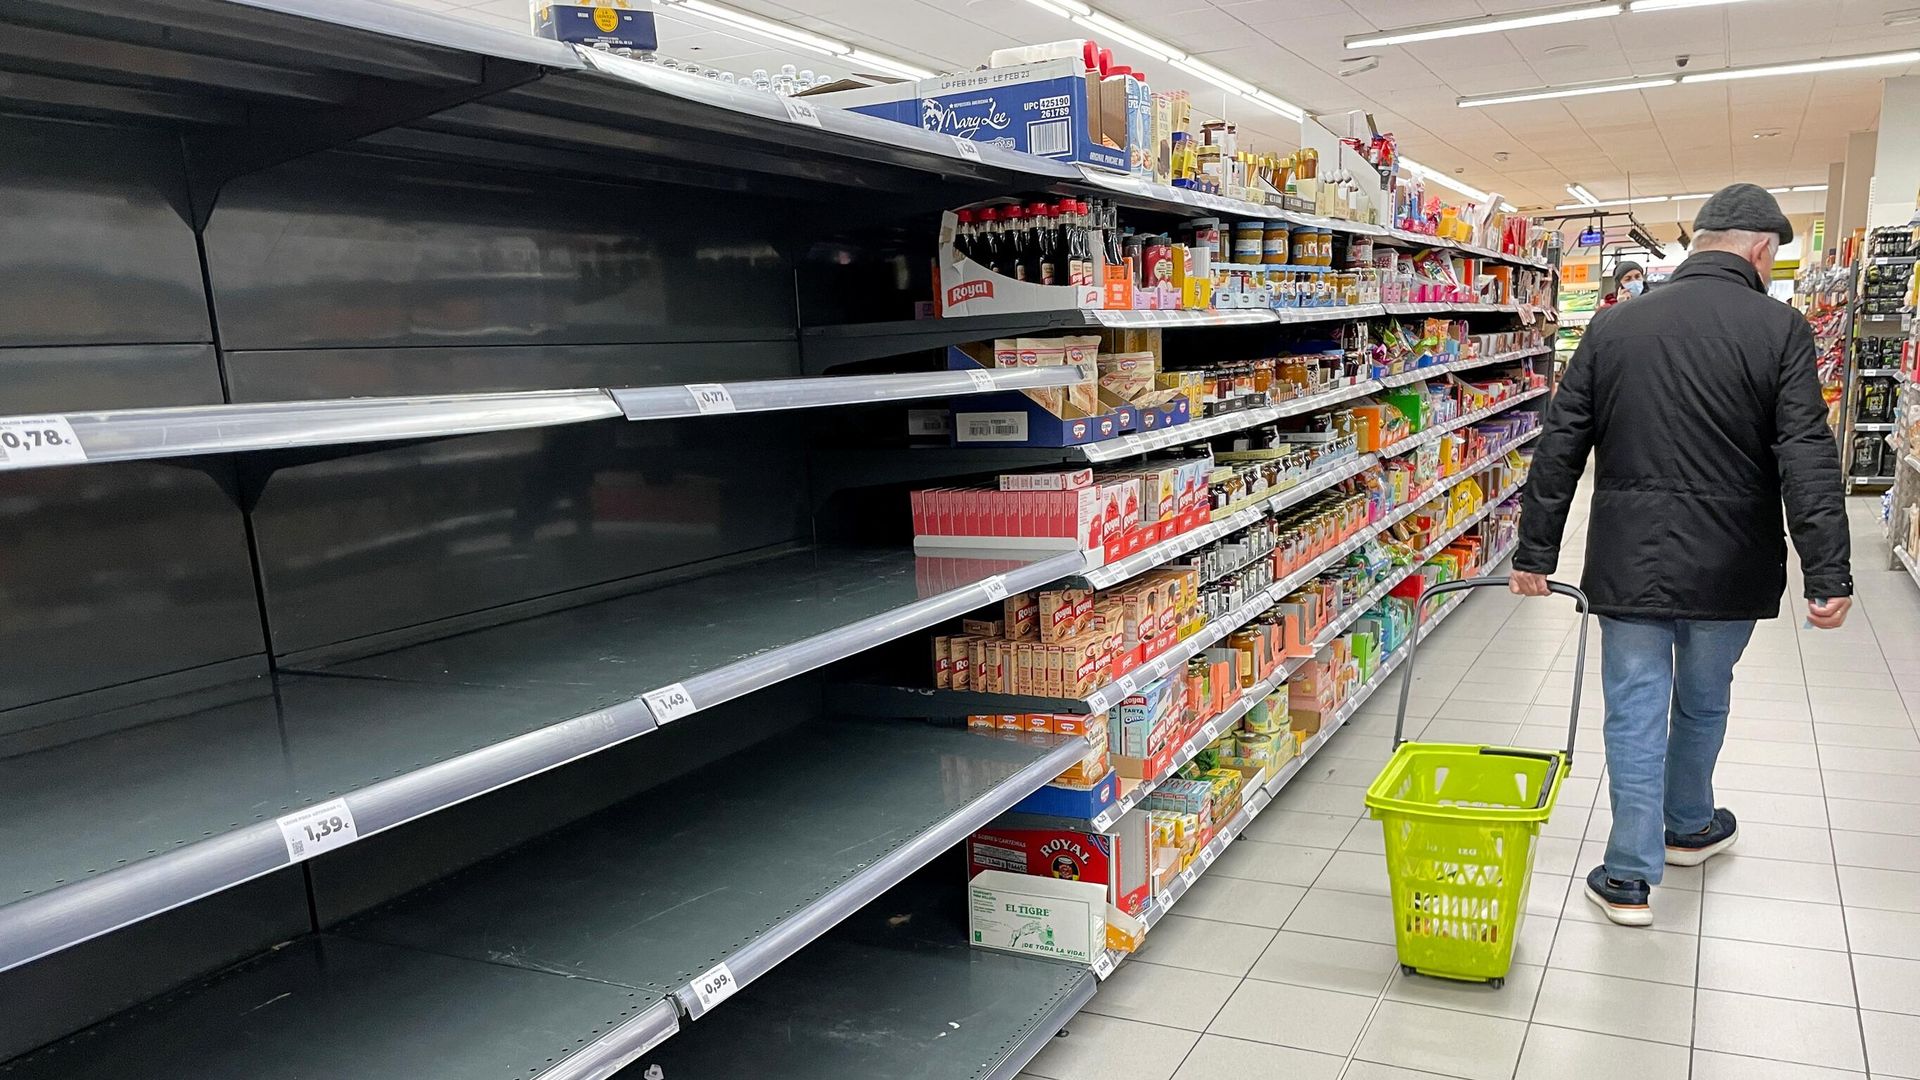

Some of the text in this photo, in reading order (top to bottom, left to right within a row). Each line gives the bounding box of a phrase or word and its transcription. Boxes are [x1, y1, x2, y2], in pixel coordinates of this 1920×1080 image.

[1005, 72, 1019, 80] FEB
[1024, 96, 1069, 111] UPC 425190
[1041, 107, 1069, 118] 261789
[938, 101, 1011, 140] Mary Lee
[952, 281, 988, 301] Royal
[1055, 607, 1072, 622] Royal
[1076, 600, 1092, 616] Royal
[1078, 661, 1095, 679] Royal
[1096, 655, 1111, 670] Royal
[1040, 839, 1091, 865] ROYAL
[1006, 904, 1050, 916] EL TIGRE
